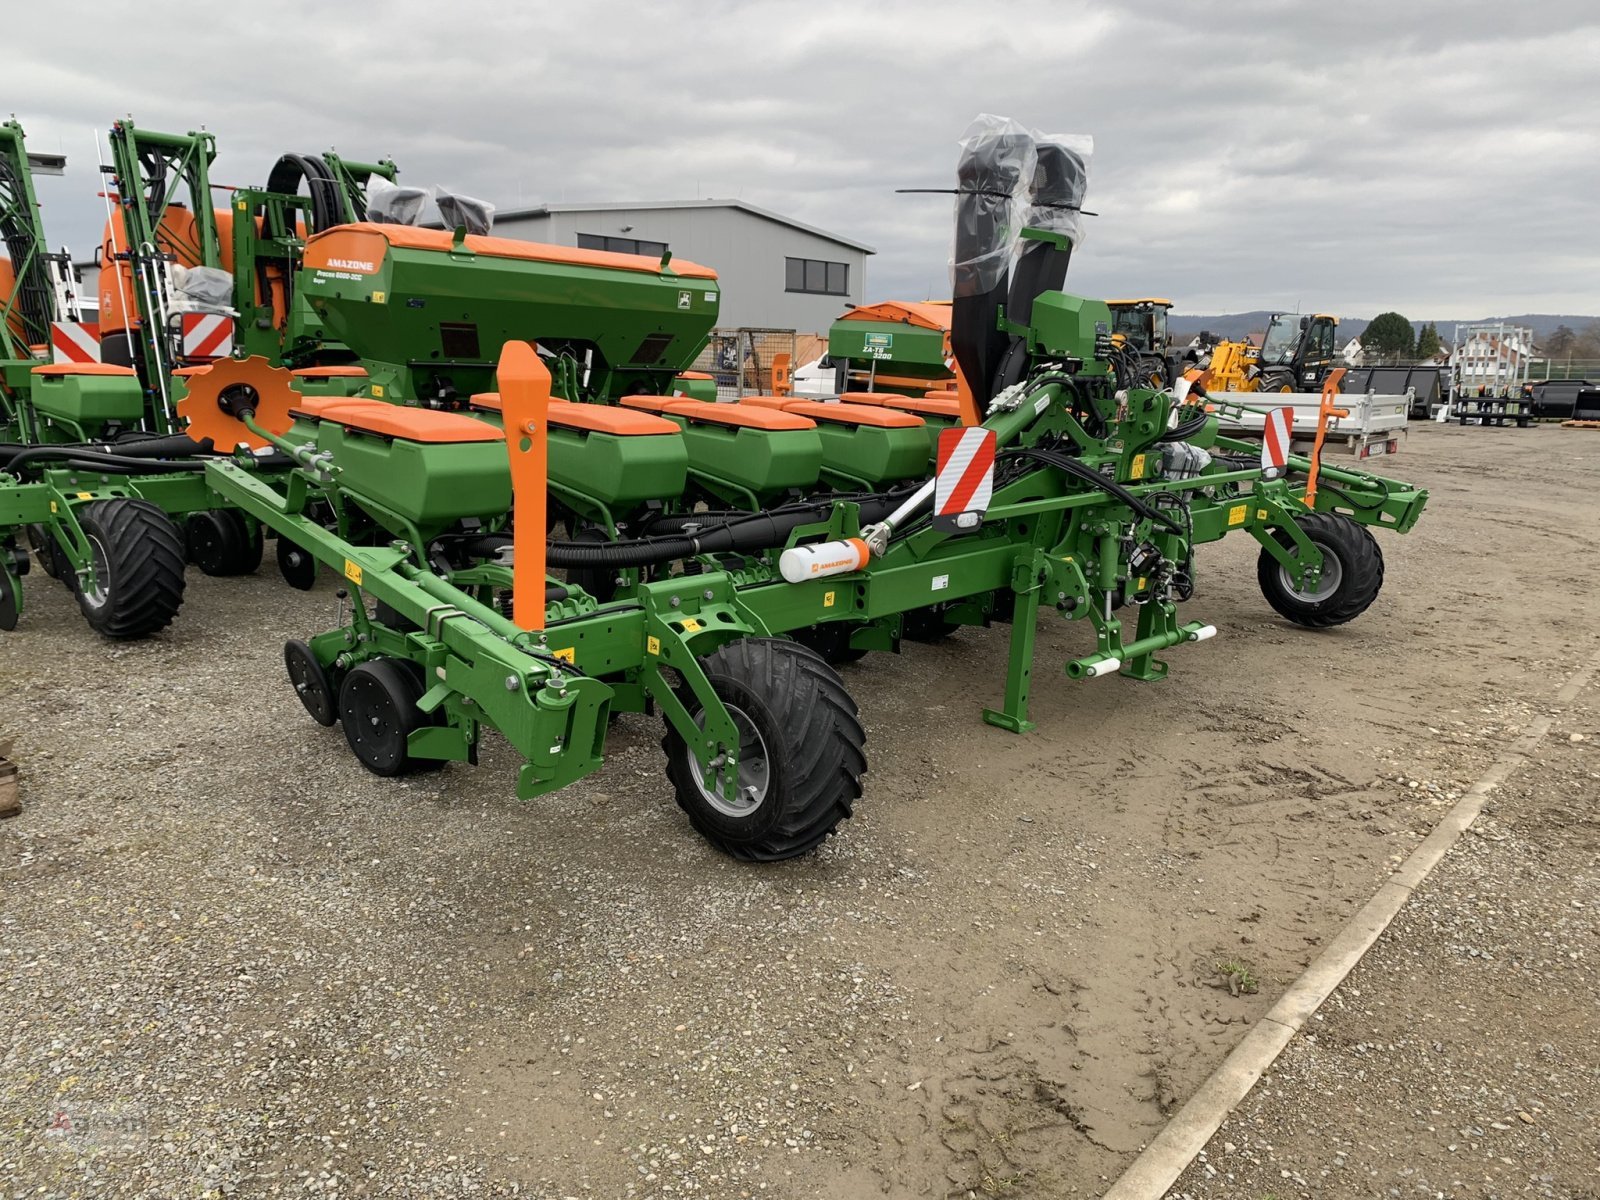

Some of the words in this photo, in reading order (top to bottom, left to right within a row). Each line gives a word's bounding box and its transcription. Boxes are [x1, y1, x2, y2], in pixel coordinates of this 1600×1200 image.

[326, 258, 374, 271] AMAZONE
[1246, 349, 1260, 359] JCB
[820, 559, 853, 569] AMAZONE
